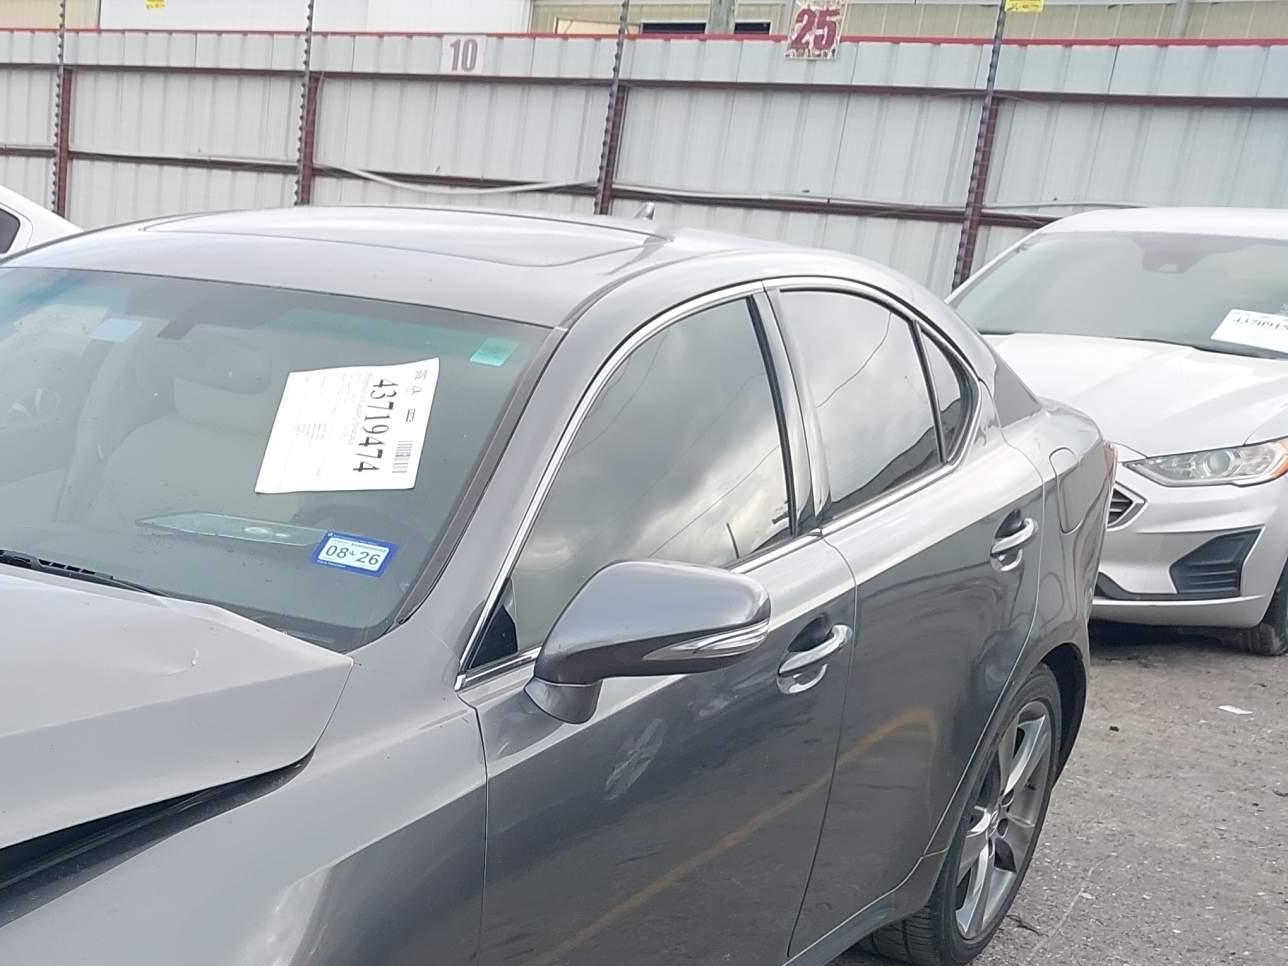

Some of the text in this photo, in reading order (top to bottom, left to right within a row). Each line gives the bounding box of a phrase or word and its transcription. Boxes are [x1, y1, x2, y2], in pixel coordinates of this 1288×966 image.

[789, 7, 840, 49] 25
[450, 39, 478, 72] 10
[353, 379, 398, 472] 43719474
[325, 545, 350, 559] 08
[355, 551, 381, 565] 26
